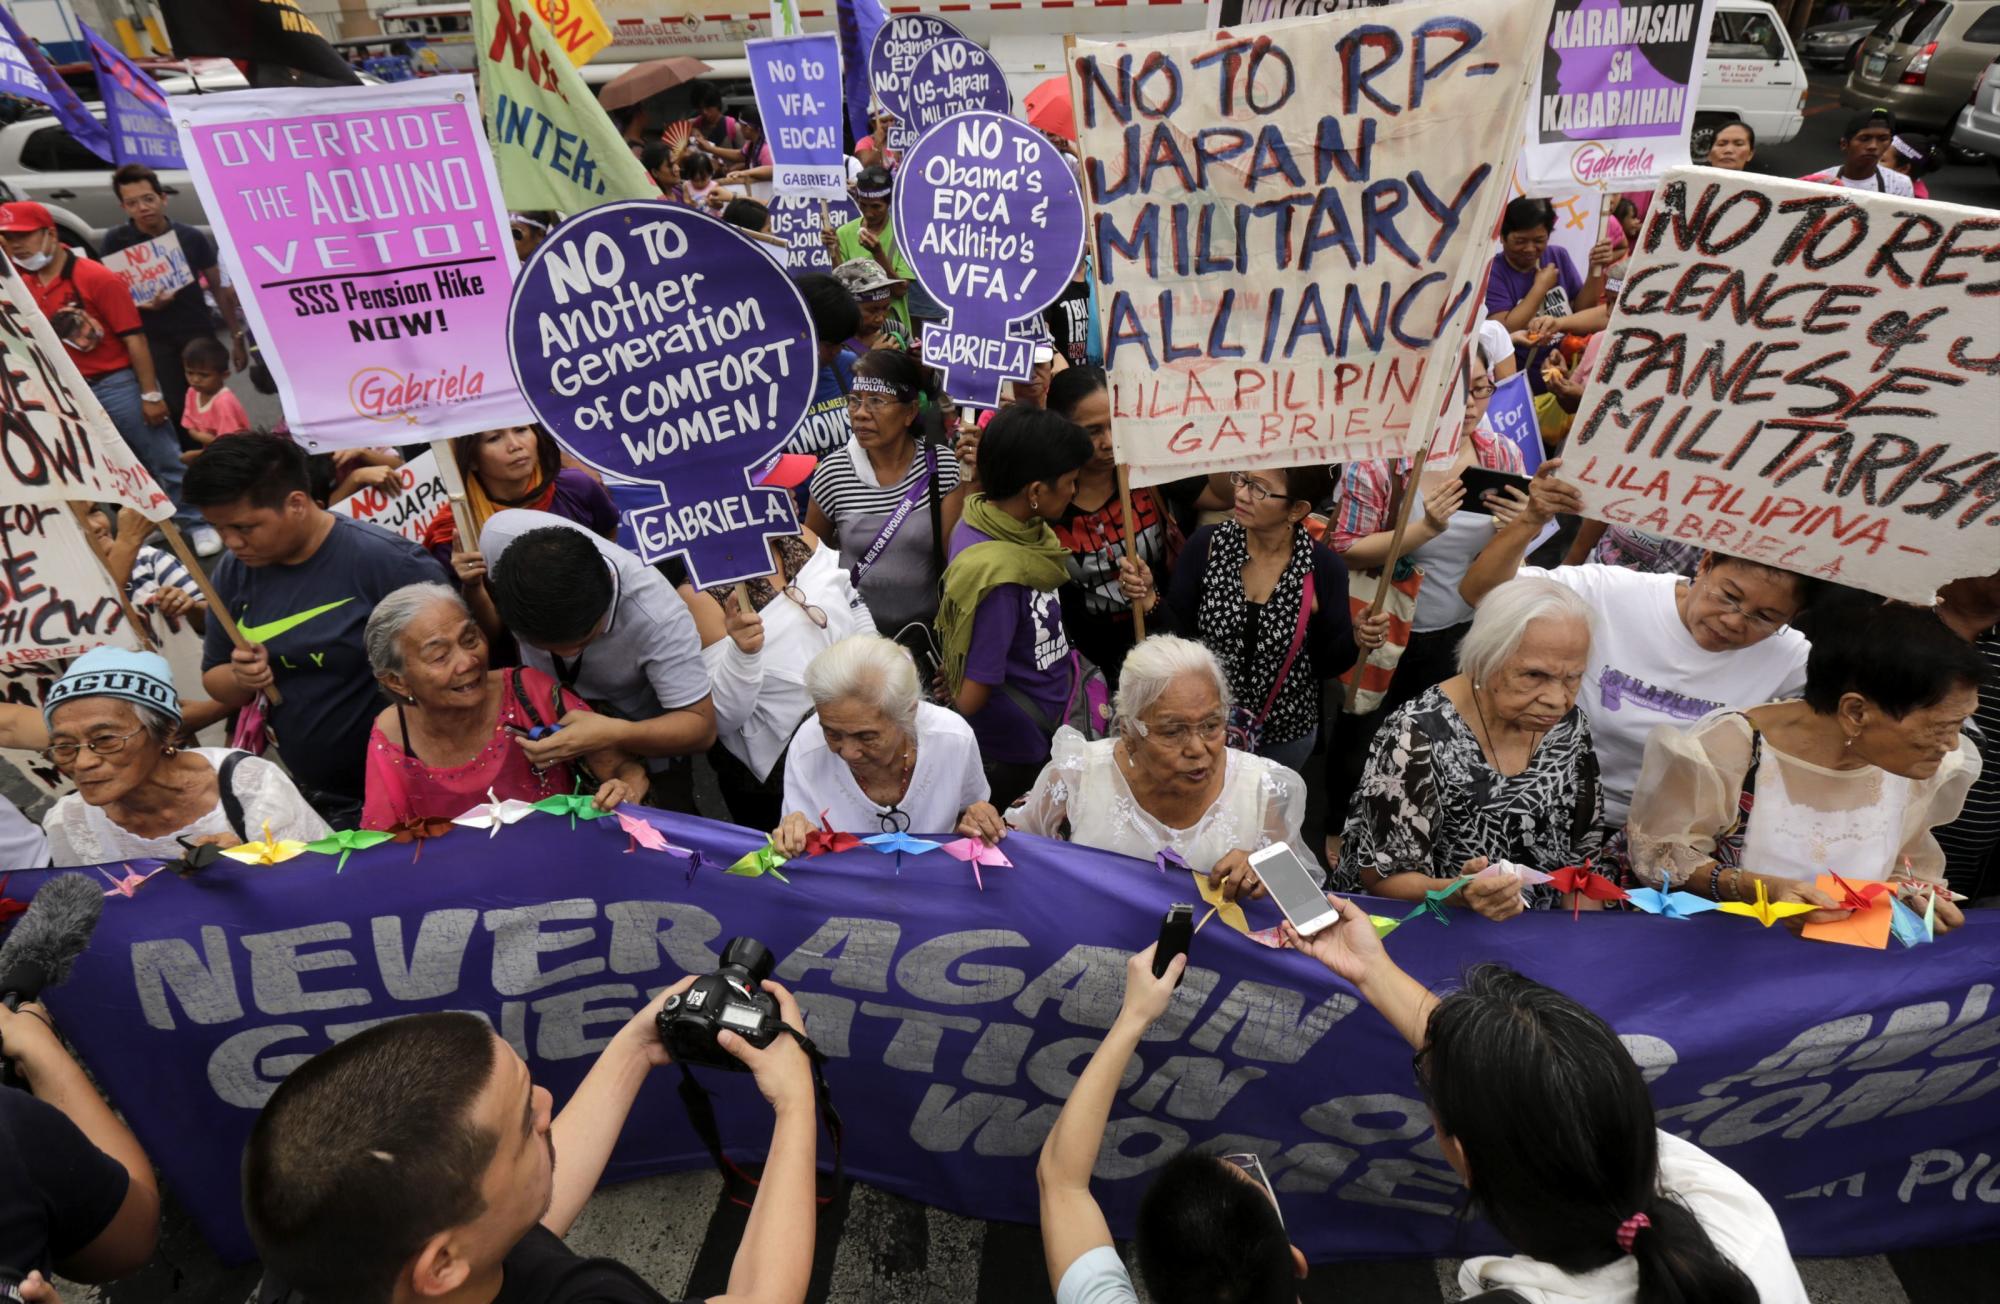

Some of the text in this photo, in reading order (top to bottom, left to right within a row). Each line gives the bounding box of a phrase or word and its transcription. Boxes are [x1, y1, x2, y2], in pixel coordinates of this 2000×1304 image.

[891, 18, 943, 40] NO TO
[1553, 3, 1695, 49] KARAHASAN
[766, 56, 825, 83] No to
[875, 71, 899, 92] NO
[931, 42, 985, 76] NO TO
[1075, 15, 1501, 129] NO TO RP-
[1607, 50, 1633, 84] SA
[777, 91, 827, 118] VFA-
[913, 73, 989, 106] US-Japan
[1542, 87, 1685, 132] KABABAIHAN
[212, 111, 459, 167] OVERRIDE
[778, 126, 837, 151] EDCA!
[957, 119, 1041, 164] NO TO
[1085, 114, 1377, 205] JAPAN
[782, 172, 842, 188] GABRIELA
[924, 155, 1043, 193] Obama's
[1575, 148, 1654, 180] Gabriela
[239, 156, 478, 225] THE AQUINO
[933, 188, 1049, 229] EDCA &
[253, 220, 491, 274] VETO!
[918, 222, 1035, 264] Akihito's
[1094, 162, 1492, 285] MILITARY
[1643, 180, 1773, 256] NO
[1772, 193, 1870, 270] TO
[124, 243, 152, 267] NO
[543, 220, 689, 304] NO TO
[288, 268, 485, 317] SSS Pension Hike
[943, 261, 1038, 303] VFA!
[1619, 262, 1882, 335] GENCE
[348, 308, 449, 343] NOW!
[538, 272, 705, 358] Another
[550, 297, 766, 397] Generation
[925, 330, 1025, 375] GABRIELA
[359, 365, 485, 416] Gabriela
[573, 338, 796, 431] of COMFORT
[1113, 369, 1216, 420] LILA
[1234, 356, 1427, 417] PILIPIN
[1596, 326, 1969, 419] PANESE
[620, 382, 779, 466] WOMEN!
[1167, 402, 1413, 455] GABRIEL
[1494, 402, 1524, 432] for
[350, 485, 388, 520] NO
[1576, 456, 1672, 503] LILA
[640, 492, 790, 552] GABRIELA
[872, 537, 886, 552] FOR
[881, 498, 914, 540] REVOLUTION
[1600, 497, 1846, 579] GABRIELA
[0, 640, 107, 665] ABRIEL
[130, 897, 724, 1030] NEVER
[206, 983, 1268, 1121] GEATION
[909, 1082, 1465, 1215] WOME
